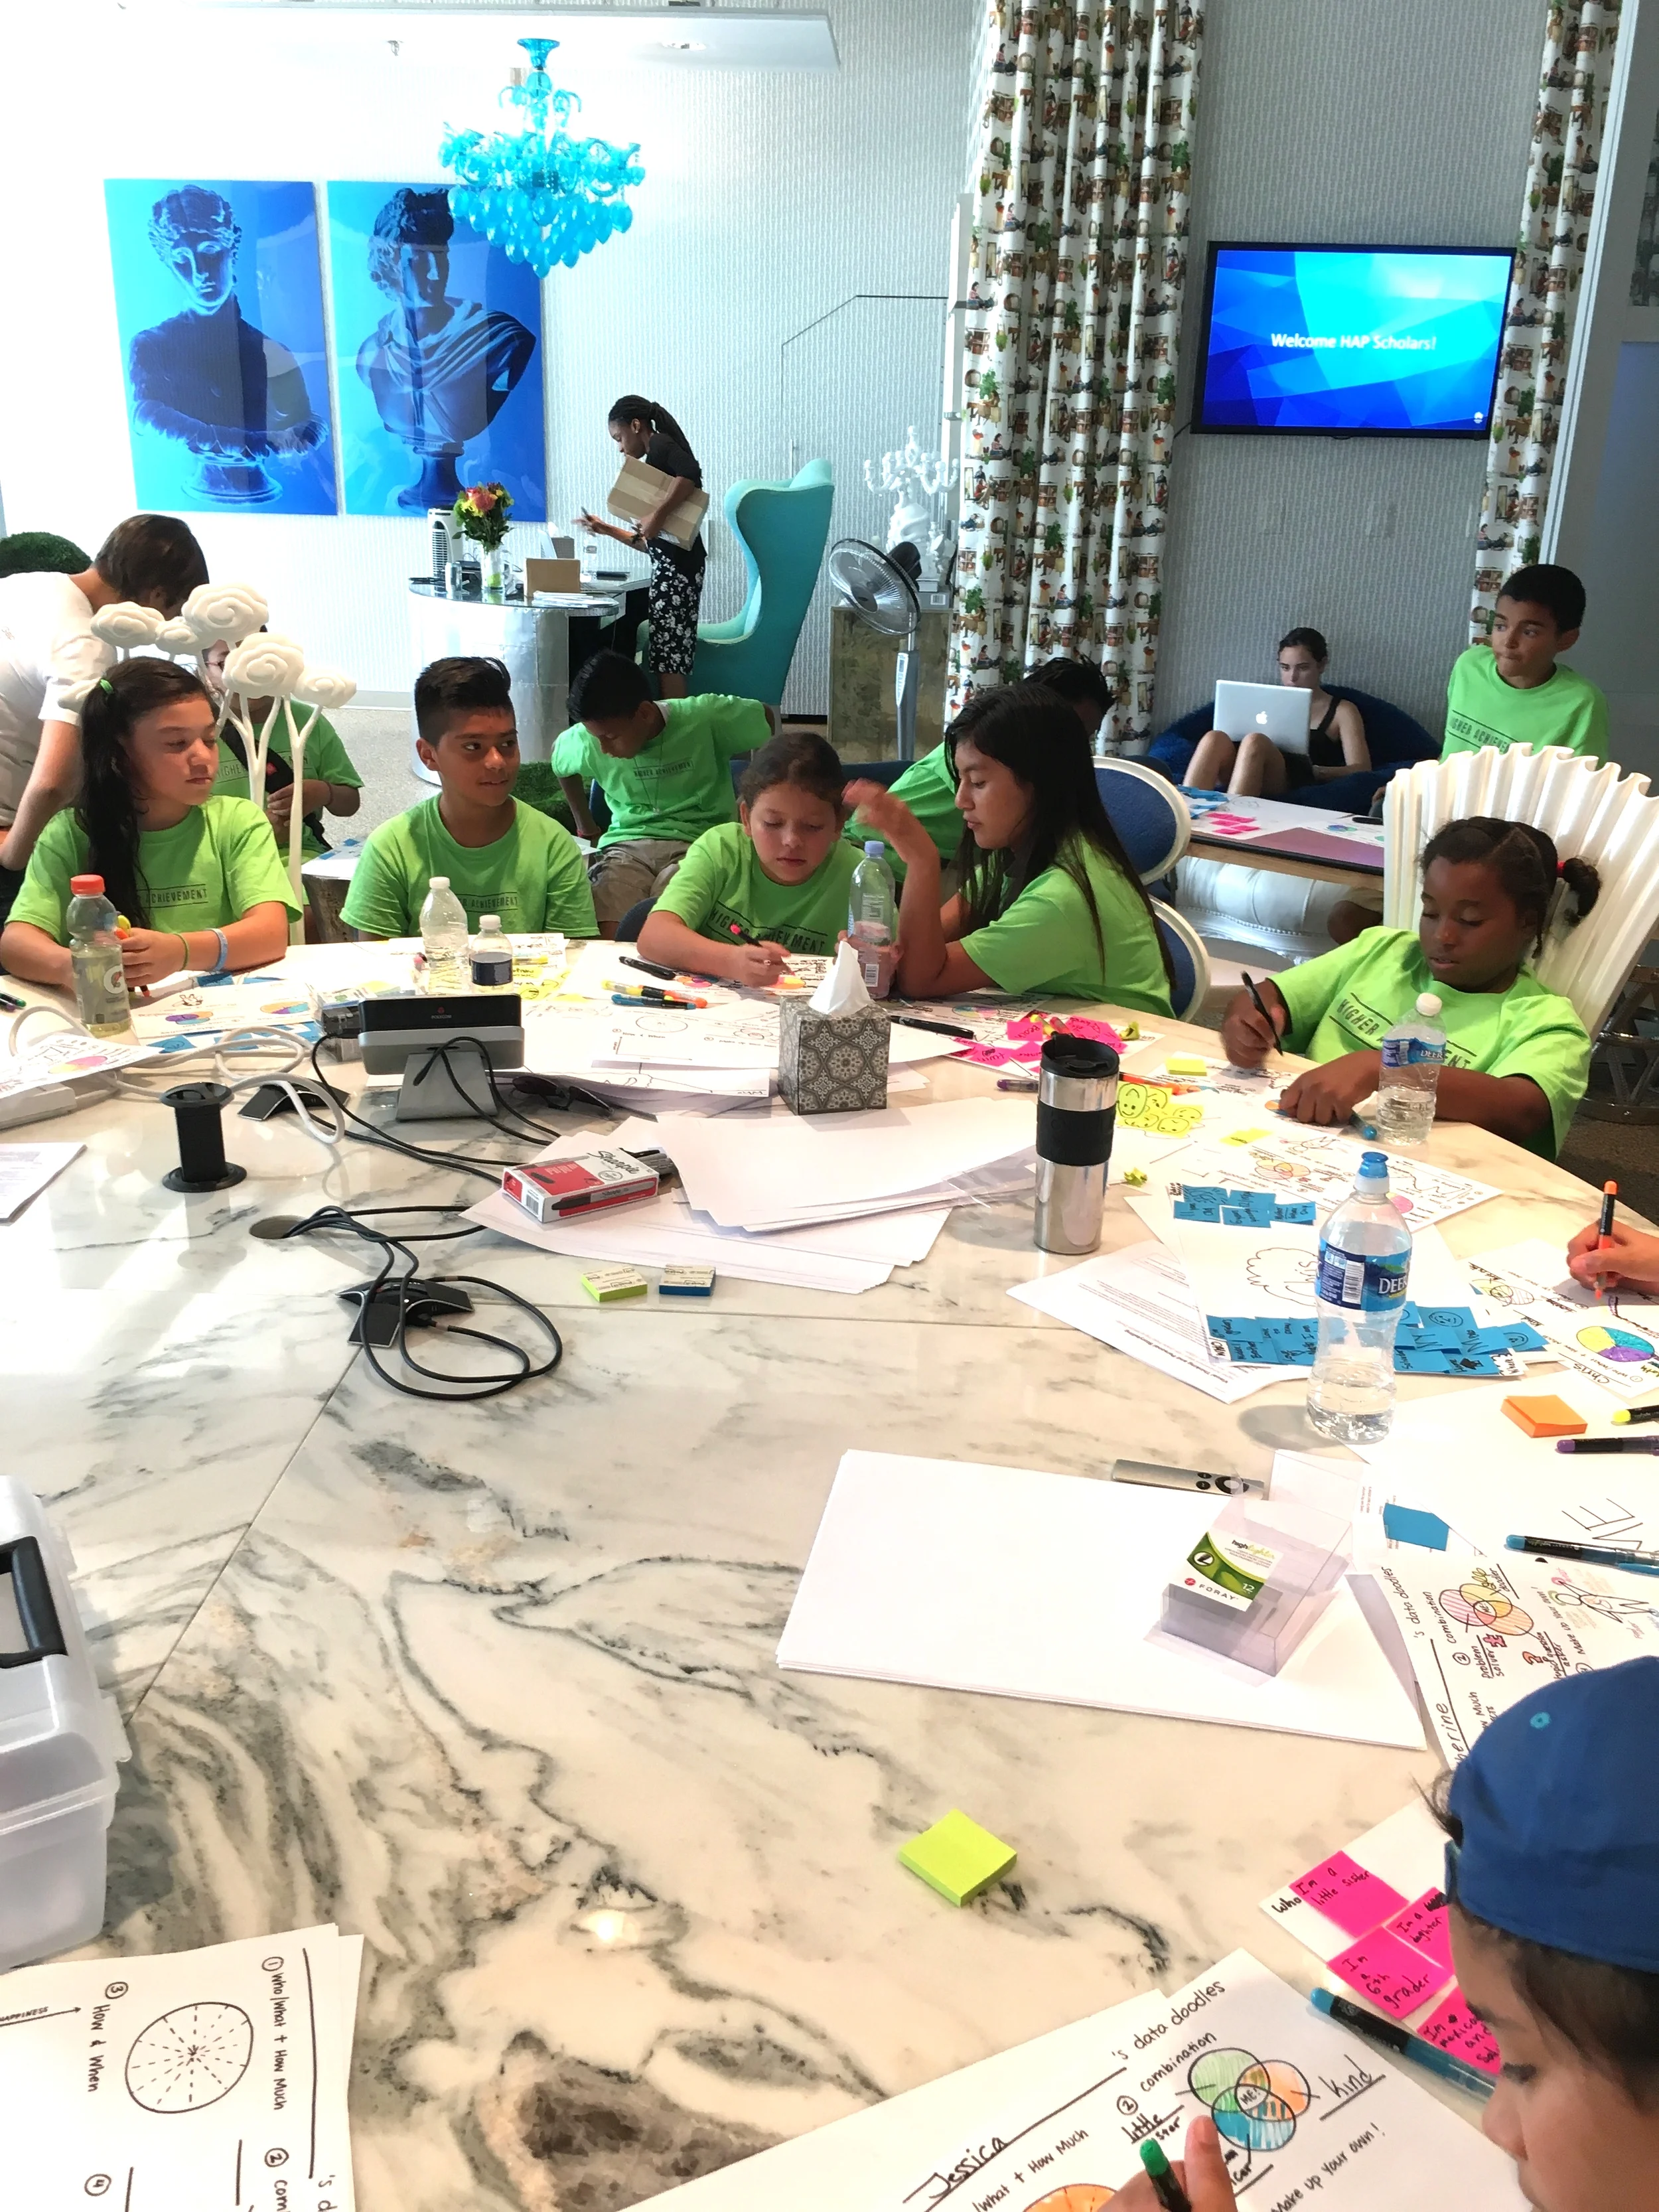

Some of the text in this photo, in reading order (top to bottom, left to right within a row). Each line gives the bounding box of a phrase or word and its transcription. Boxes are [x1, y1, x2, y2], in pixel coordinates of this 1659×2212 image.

[1271, 333, 1437, 350] Welcome HAP Scholars!
[1336, 999, 1380, 1035] HIGHER
[587, 1150, 641, 1175] Sharpie
[1573, 1363, 1610, 1384] Chris
[1198, 1584, 1237, 1600] FORAY
[1242, 1582, 1256, 1593] 12
[1382, 1566, 1409, 1599] doodles
[1403, 1601, 1421, 1625] data
[1422, 1590, 1457, 1644] combination
[1327, 1866, 1338, 1878] a
[1309, 1870, 1370, 1907] little sister
[269, 1972, 290, 2027] Who/What
[1382, 1973, 1431, 2010] grader
[90, 2004, 111, 2031] How
[87, 2053, 106, 2093] When
[273, 2049, 288, 2073] How
[1139, 2030, 1218, 2093] combination
[273, 2077, 288, 2110] Much
[912, 2136, 1011, 2201] Jessica
[1133, 2022, 1169, 2050] data
[1170, 1979, 1226, 2026] doodles
[1119, 2112, 1165, 2144] little
[1027, 2152, 1055, 2175] How
[1054, 2128, 1091, 2156] Much
[1305, 2174, 1326, 2191] up
